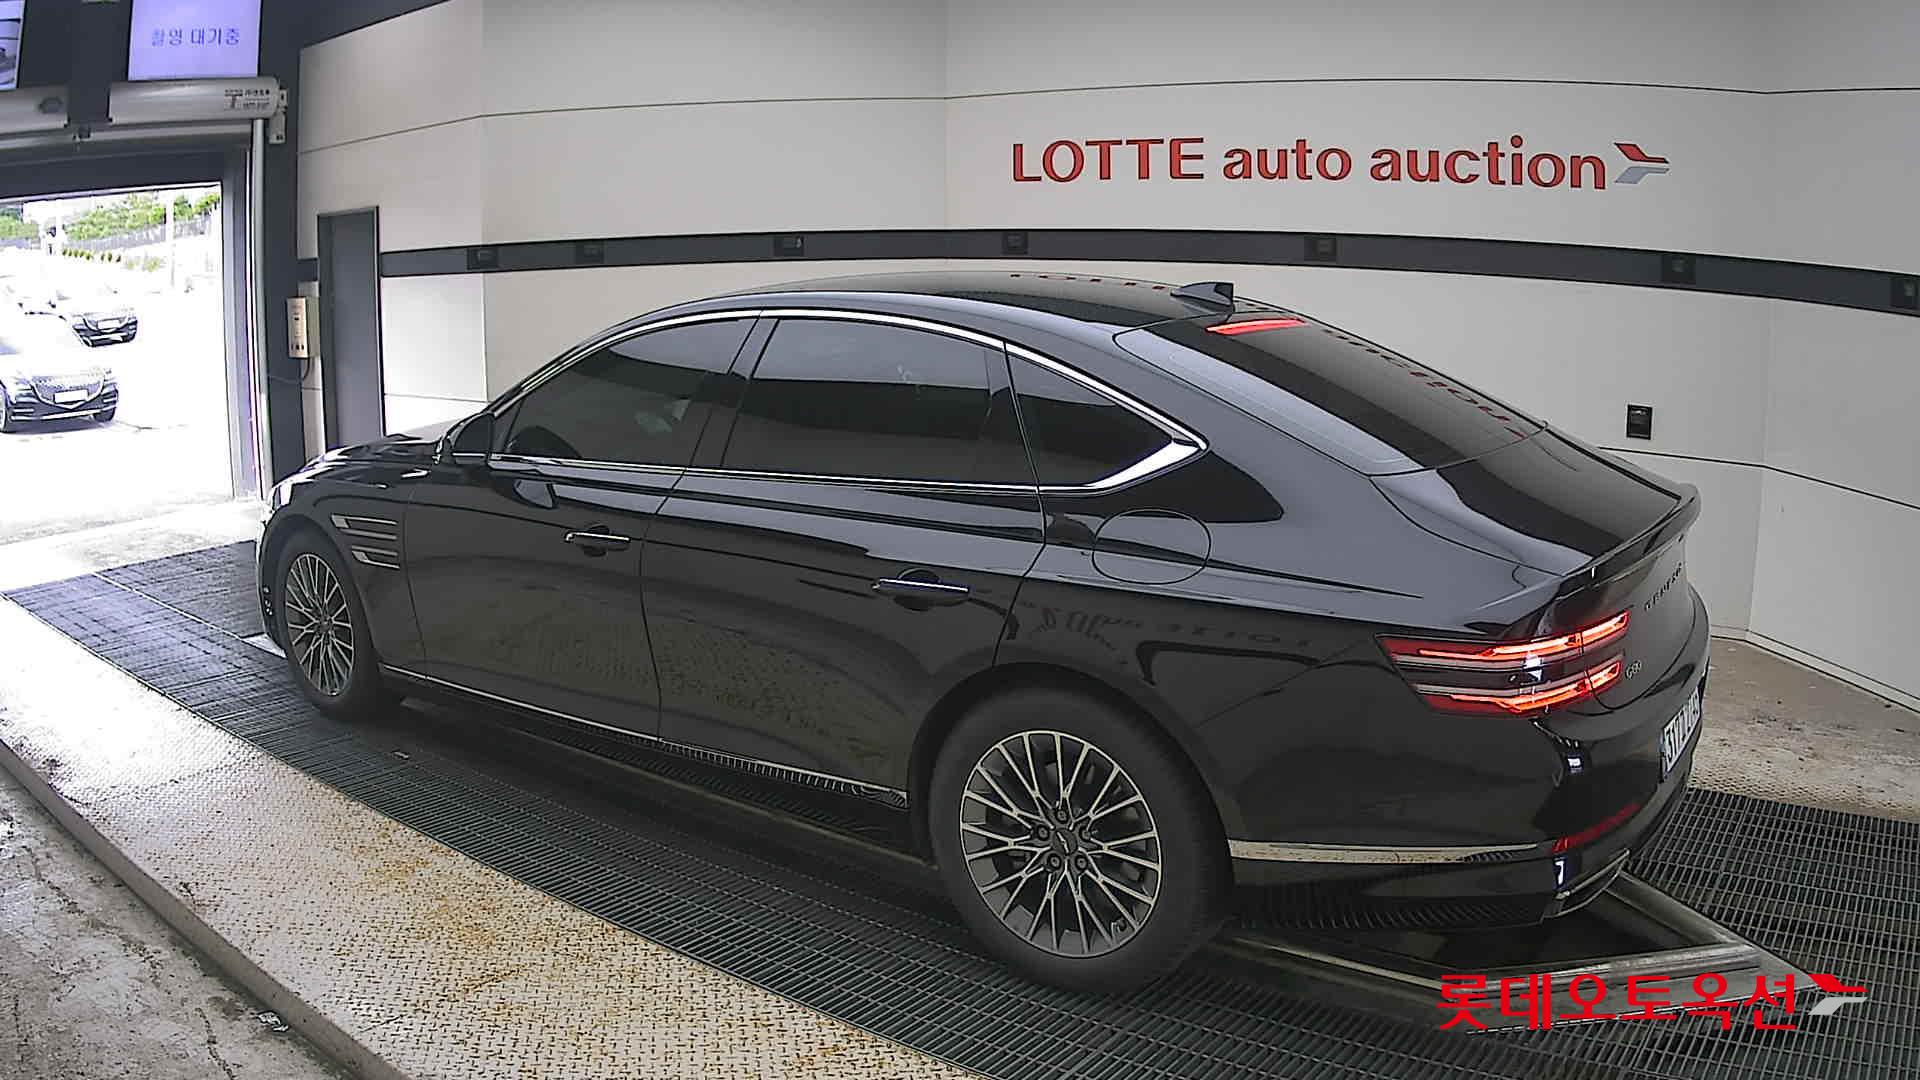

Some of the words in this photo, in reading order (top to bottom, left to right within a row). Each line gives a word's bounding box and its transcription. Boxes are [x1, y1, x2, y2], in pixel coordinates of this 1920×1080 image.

[191, 27, 240, 46] 대기중
[1012, 137, 1205, 183] LOTTE
[1222, 138, 1353, 182] auto
[1369, 135, 1607, 190] auction
